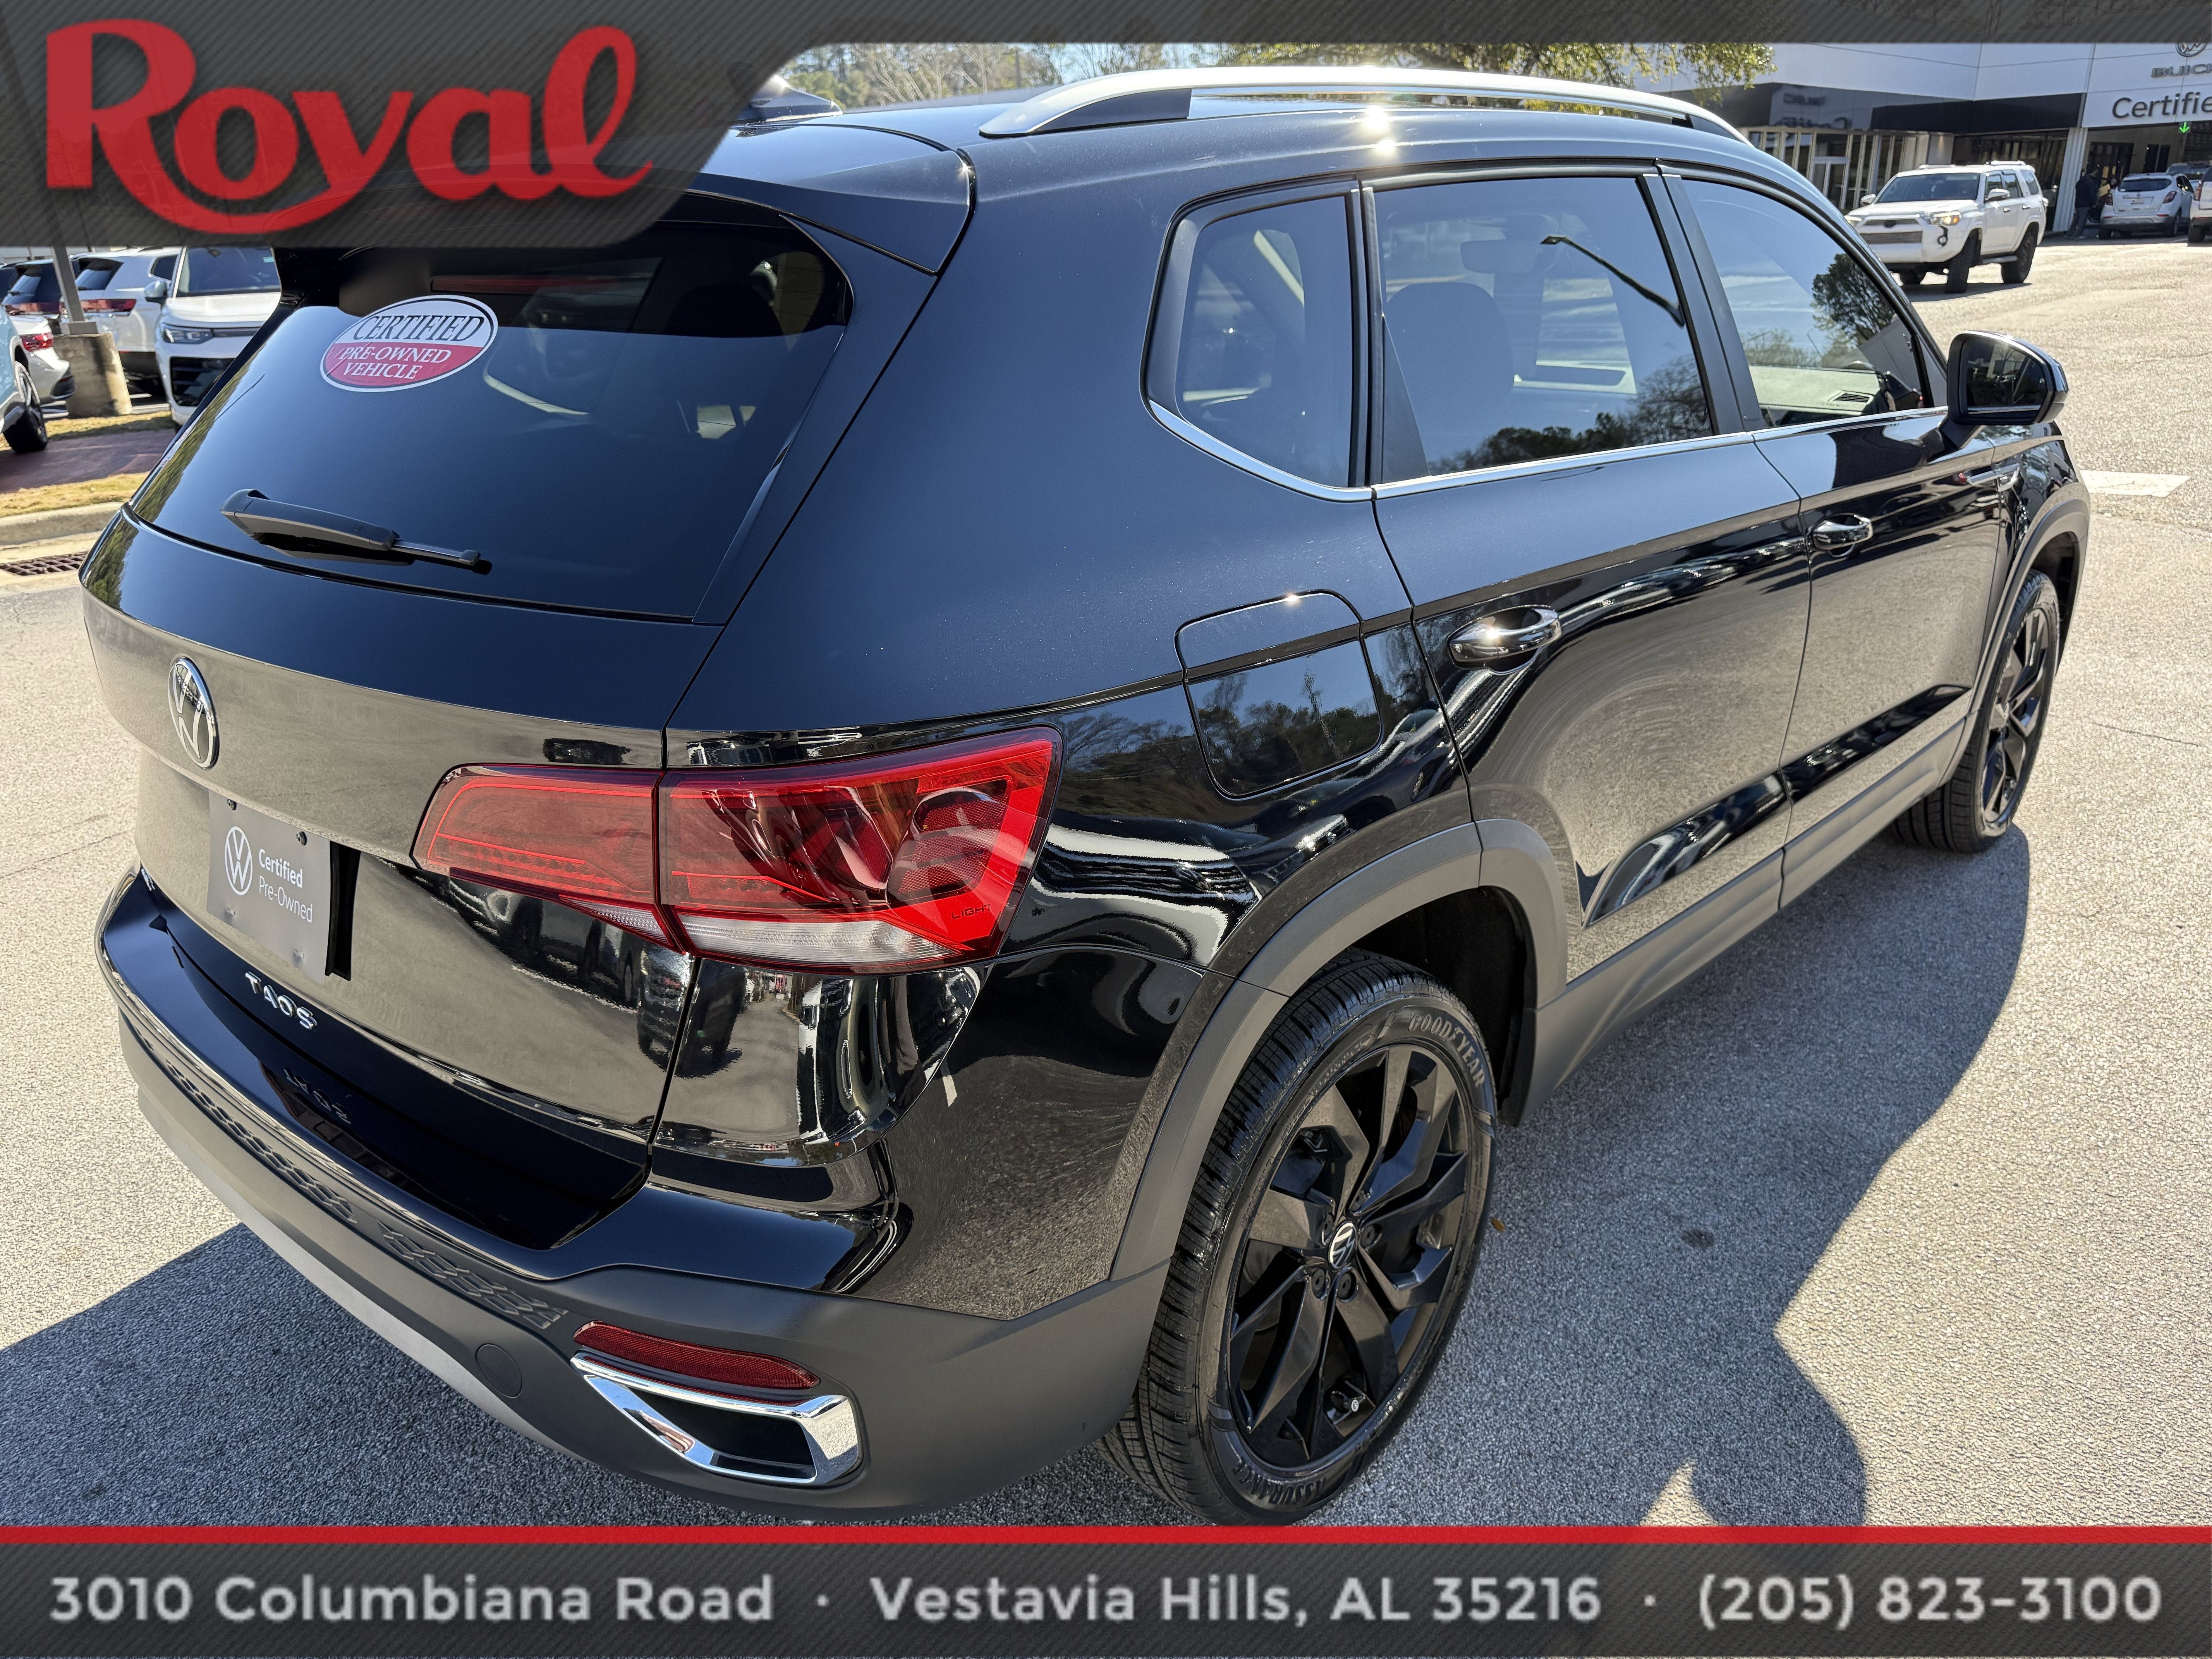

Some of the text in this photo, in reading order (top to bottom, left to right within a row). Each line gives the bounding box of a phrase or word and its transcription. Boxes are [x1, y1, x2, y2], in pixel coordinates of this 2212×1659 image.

[353, 315, 485, 342] CERTIFIED
[338, 347, 452, 364] PRE-OWNED
[342, 362, 423, 380] VEHICLE
[258, 848, 303, 889] Certified
[259, 875, 313, 923] Pre-Owned
[951, 903, 992, 919] LIGHT
[245, 971, 318, 1030] TAOS
[1408, 1012, 1486, 1088] GOODYEAR
[1231, 1455, 1327, 1505] ASSURANCE
